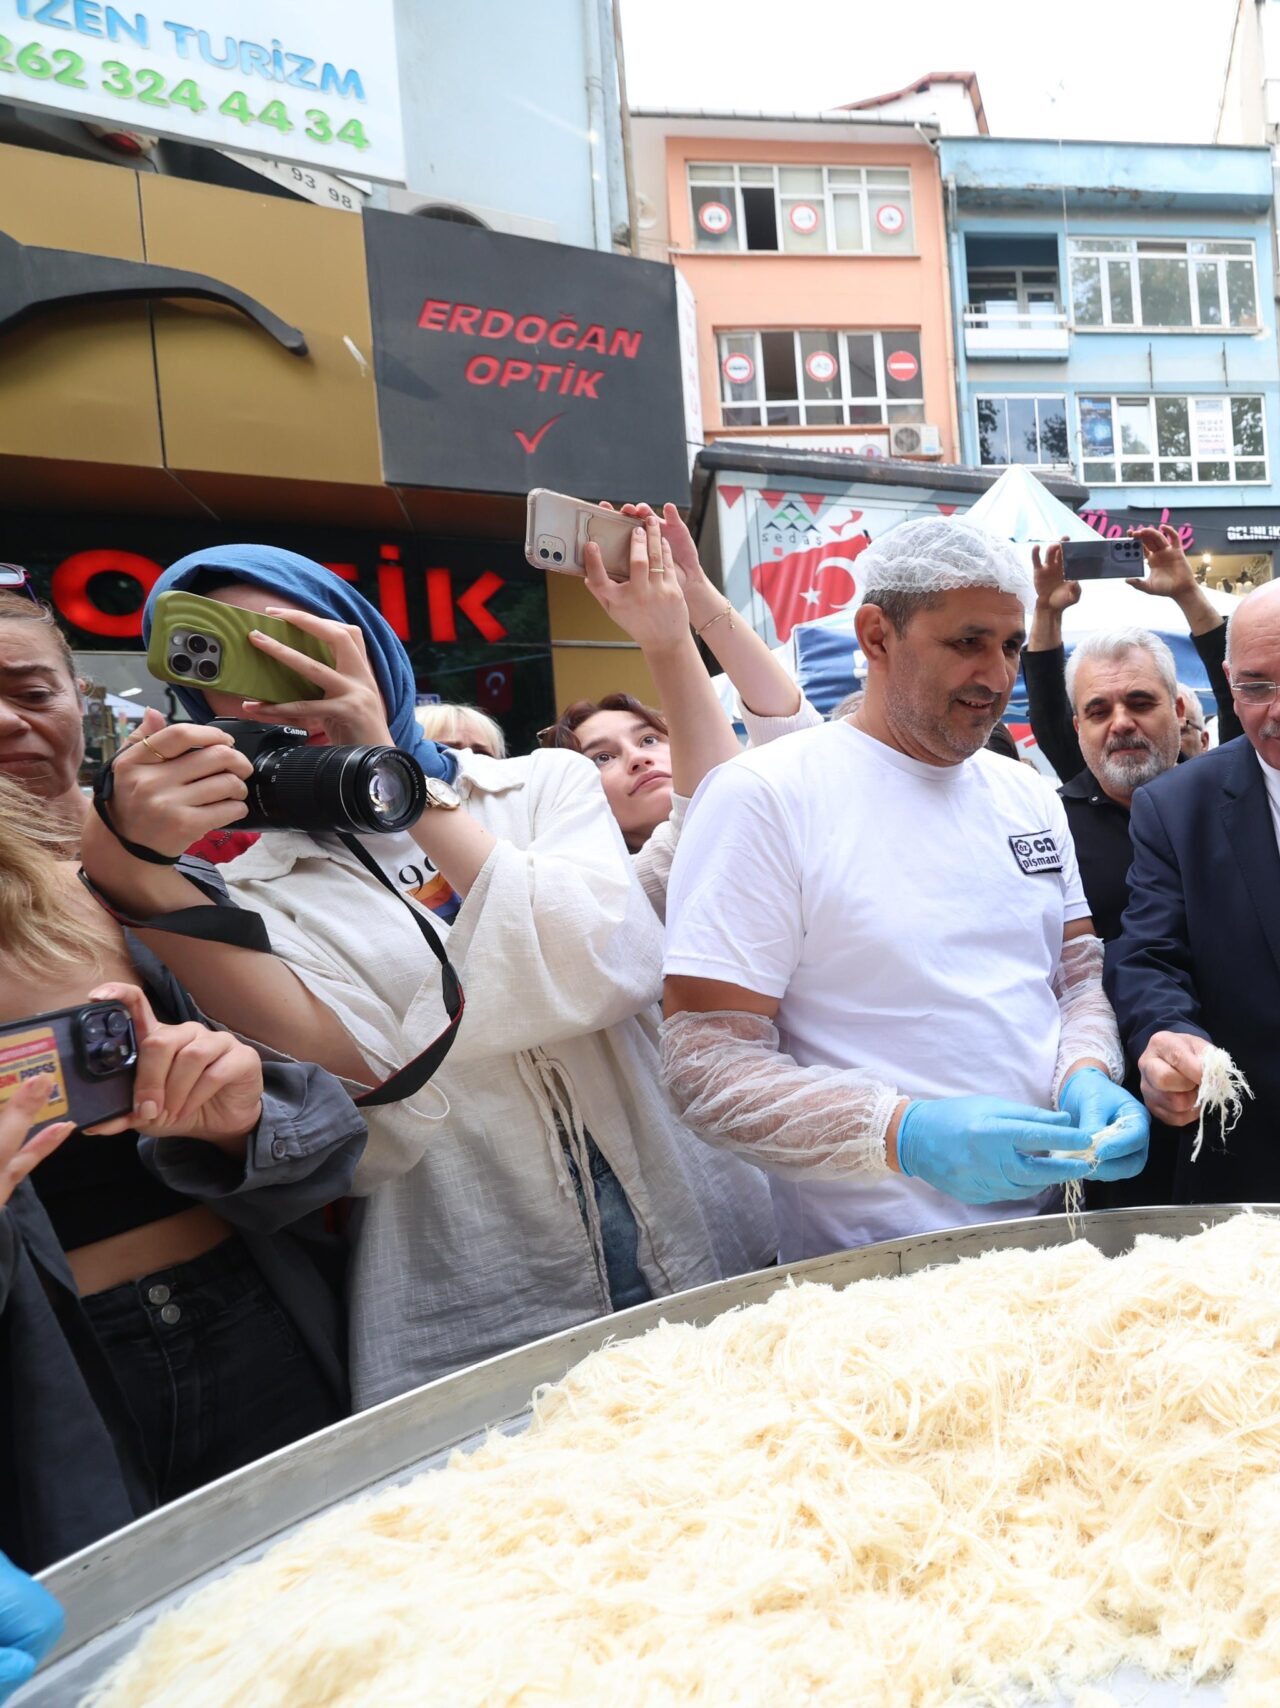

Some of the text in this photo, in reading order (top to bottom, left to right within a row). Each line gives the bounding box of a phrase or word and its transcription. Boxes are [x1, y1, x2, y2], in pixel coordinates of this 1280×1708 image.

[163, 20, 366, 101] TURİZM
[101, 60, 207, 113] 324
[219, 91, 295, 134] 44
[305, 109, 371, 152] 34
[291, 167, 352, 209] 93 98
[417, 298, 643, 359] ERDOĞAN
[464, 354, 605, 399] OPTİK
[50, 544, 508, 643] OİK
[283, 726, 308, 737] Canon
